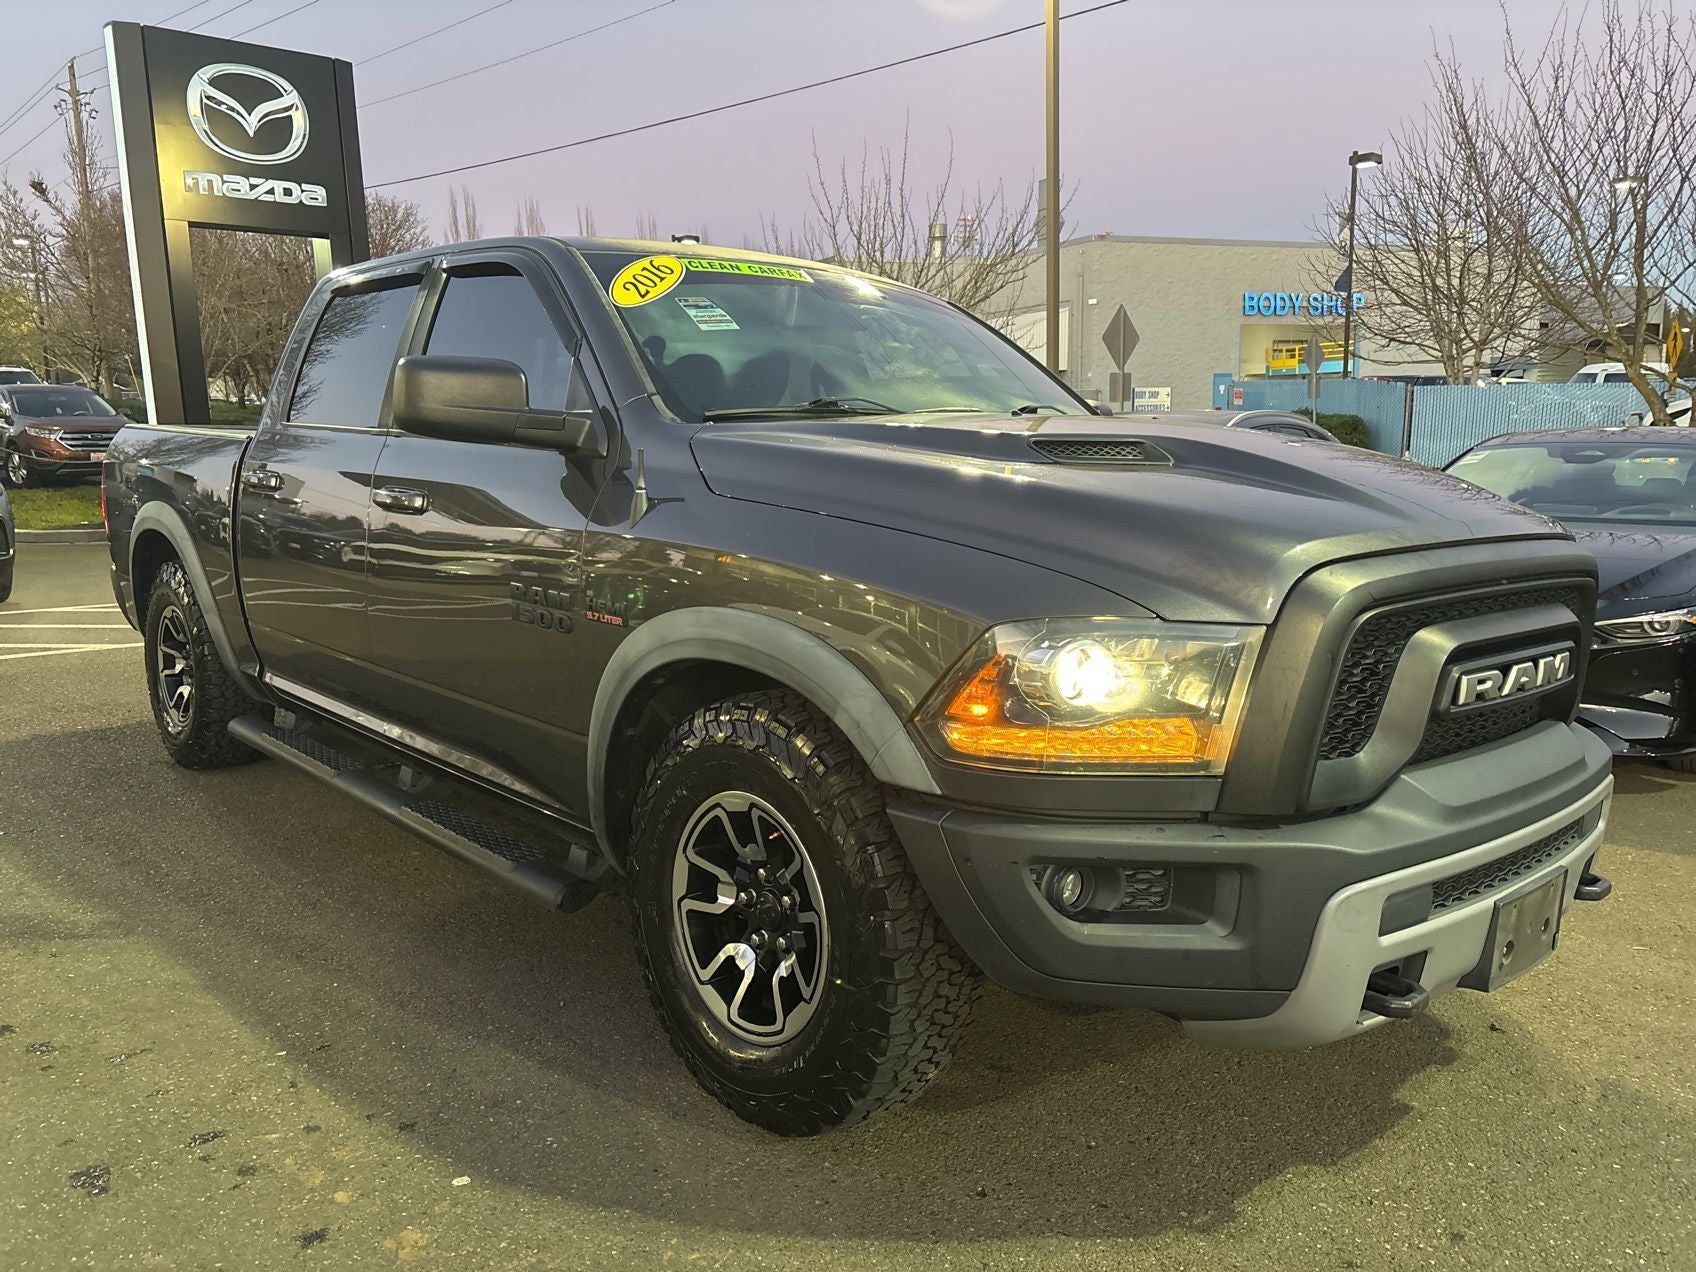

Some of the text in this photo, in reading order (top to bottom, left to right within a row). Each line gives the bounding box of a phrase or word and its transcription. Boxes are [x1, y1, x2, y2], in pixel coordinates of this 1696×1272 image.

[623, 259, 675, 299] 2016
[688, 260, 808, 280] CLEAN CARFAX
[1244, 291, 1303, 316] BODY
[510, 582, 573, 612] RAM
[586, 597, 627, 616] HEMI
[512, 601, 574, 634] 1500
[600, 613, 623, 626] LITER
[1458, 651, 1571, 705] RAM
